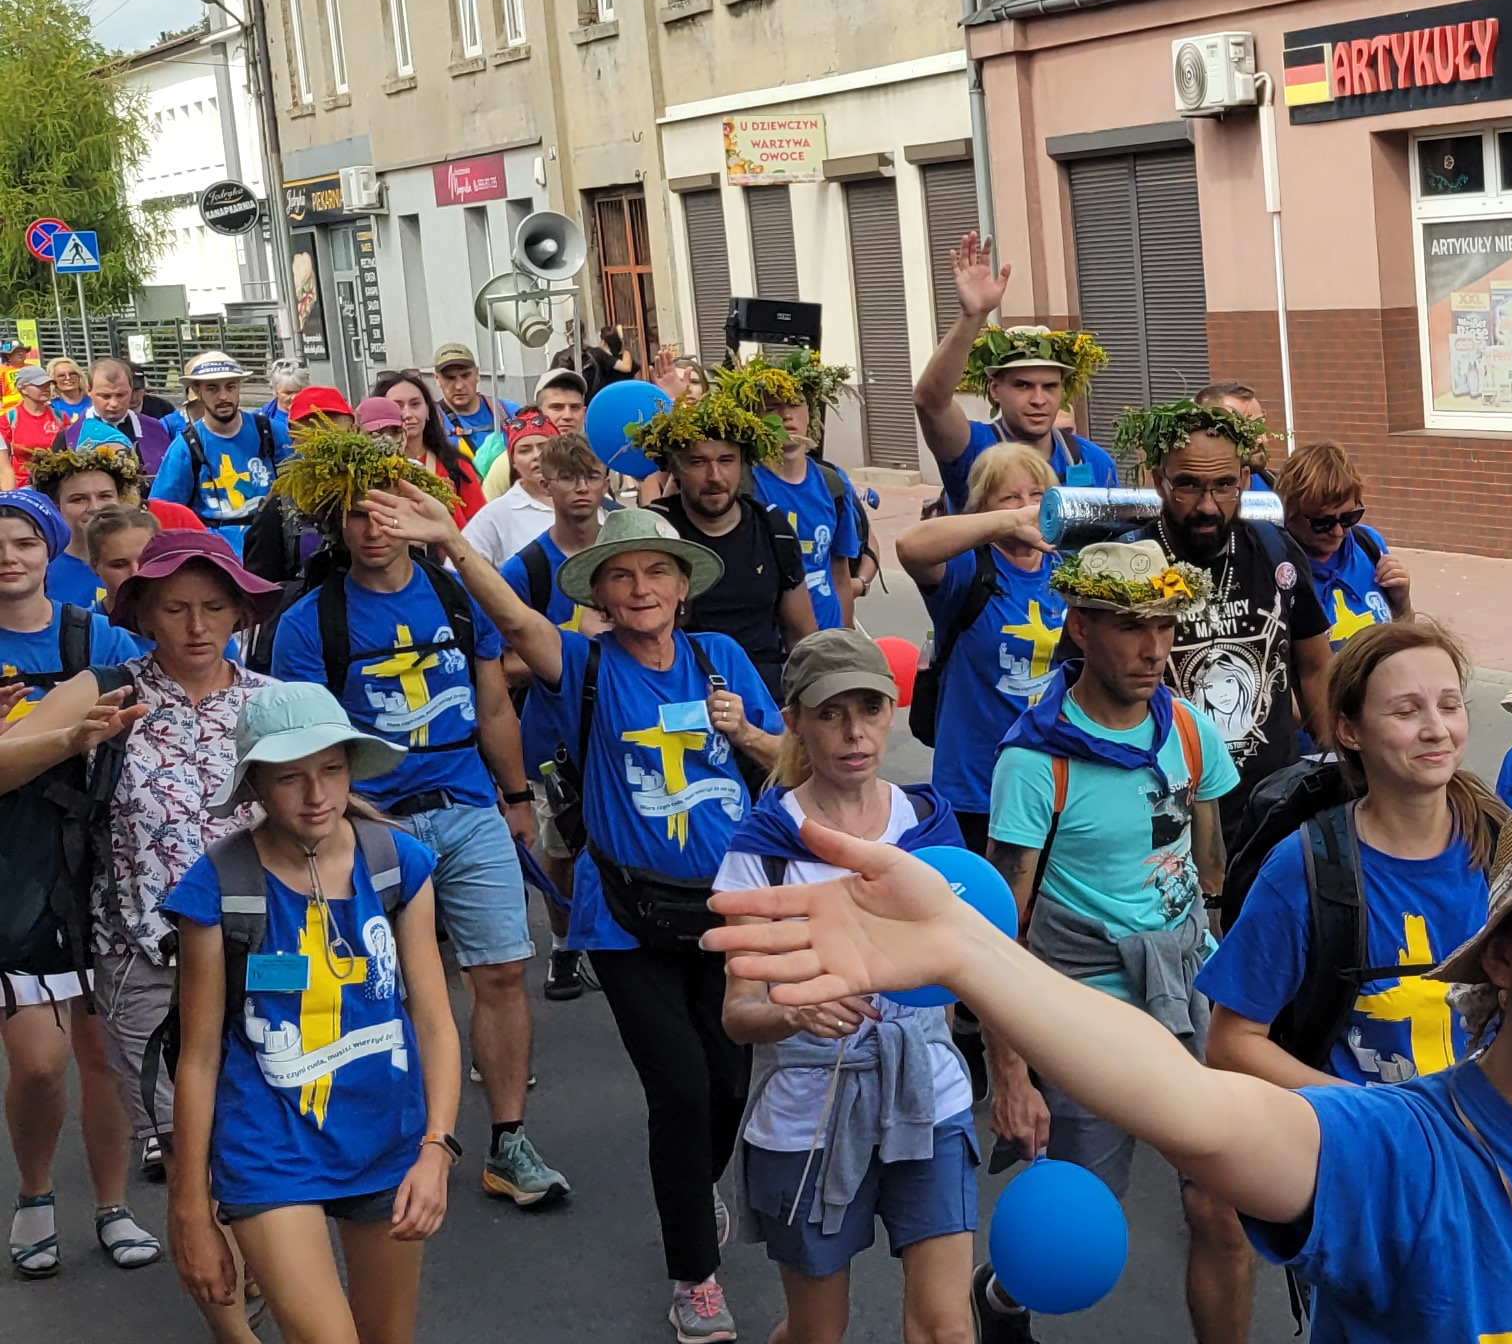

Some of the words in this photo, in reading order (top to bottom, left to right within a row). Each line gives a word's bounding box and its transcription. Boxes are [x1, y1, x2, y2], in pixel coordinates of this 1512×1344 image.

[1333, 18, 1499, 97] ARTYKUŁY
[740, 121, 748, 132] U
[751, 120, 818, 131] DZIEWCZYN
[750, 138, 811, 149] WARZYWA
[759, 152, 805, 162] OWOCE
[312, 188, 342, 212] PIEKARNI
[205, 199, 256, 220] KANAPKARNIA
[1431, 236, 1492, 256] ARTYKUŁY
[1458, 294, 1484, 305] XXL
